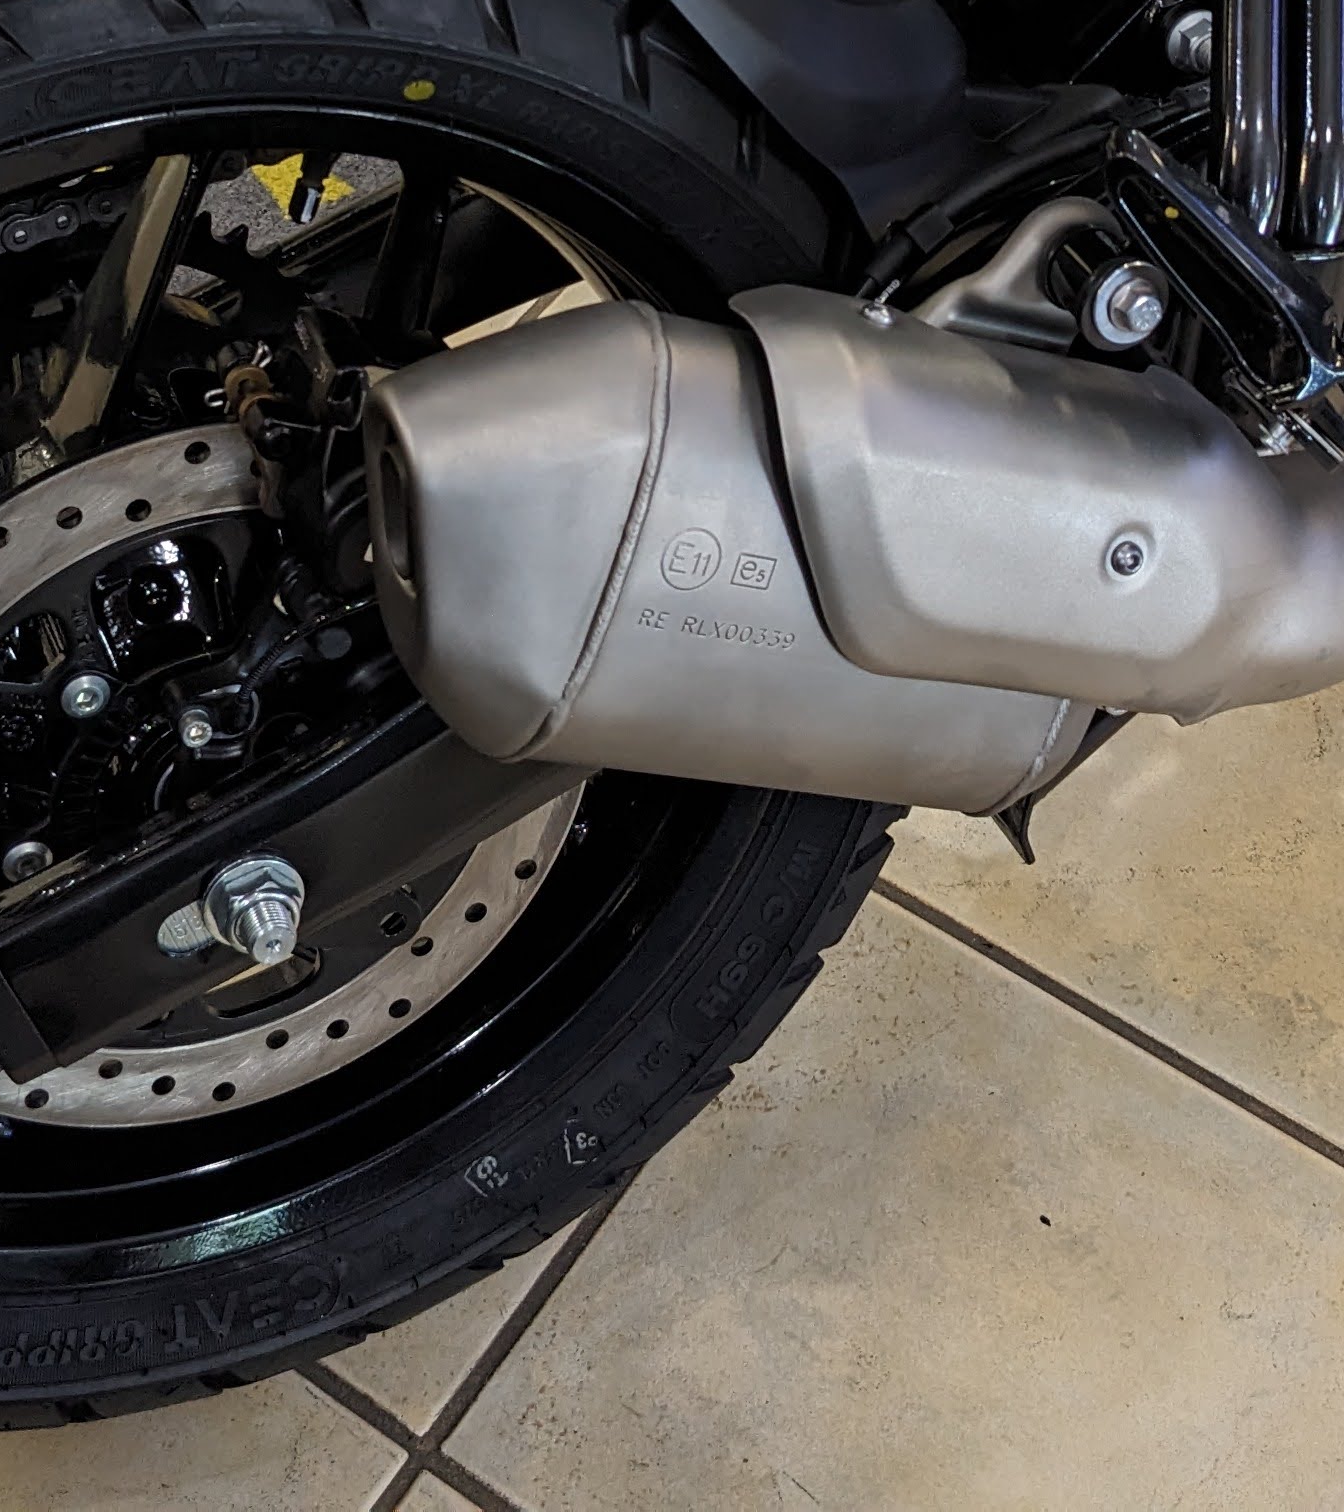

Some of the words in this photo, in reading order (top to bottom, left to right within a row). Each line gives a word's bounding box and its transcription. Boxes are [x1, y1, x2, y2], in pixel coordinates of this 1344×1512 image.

[668, 541, 712, 577] E11
[637, 607, 670, 630] RE
[680, 615, 796, 650] RLX00339
[162, 1263, 340, 1352] CEAT
